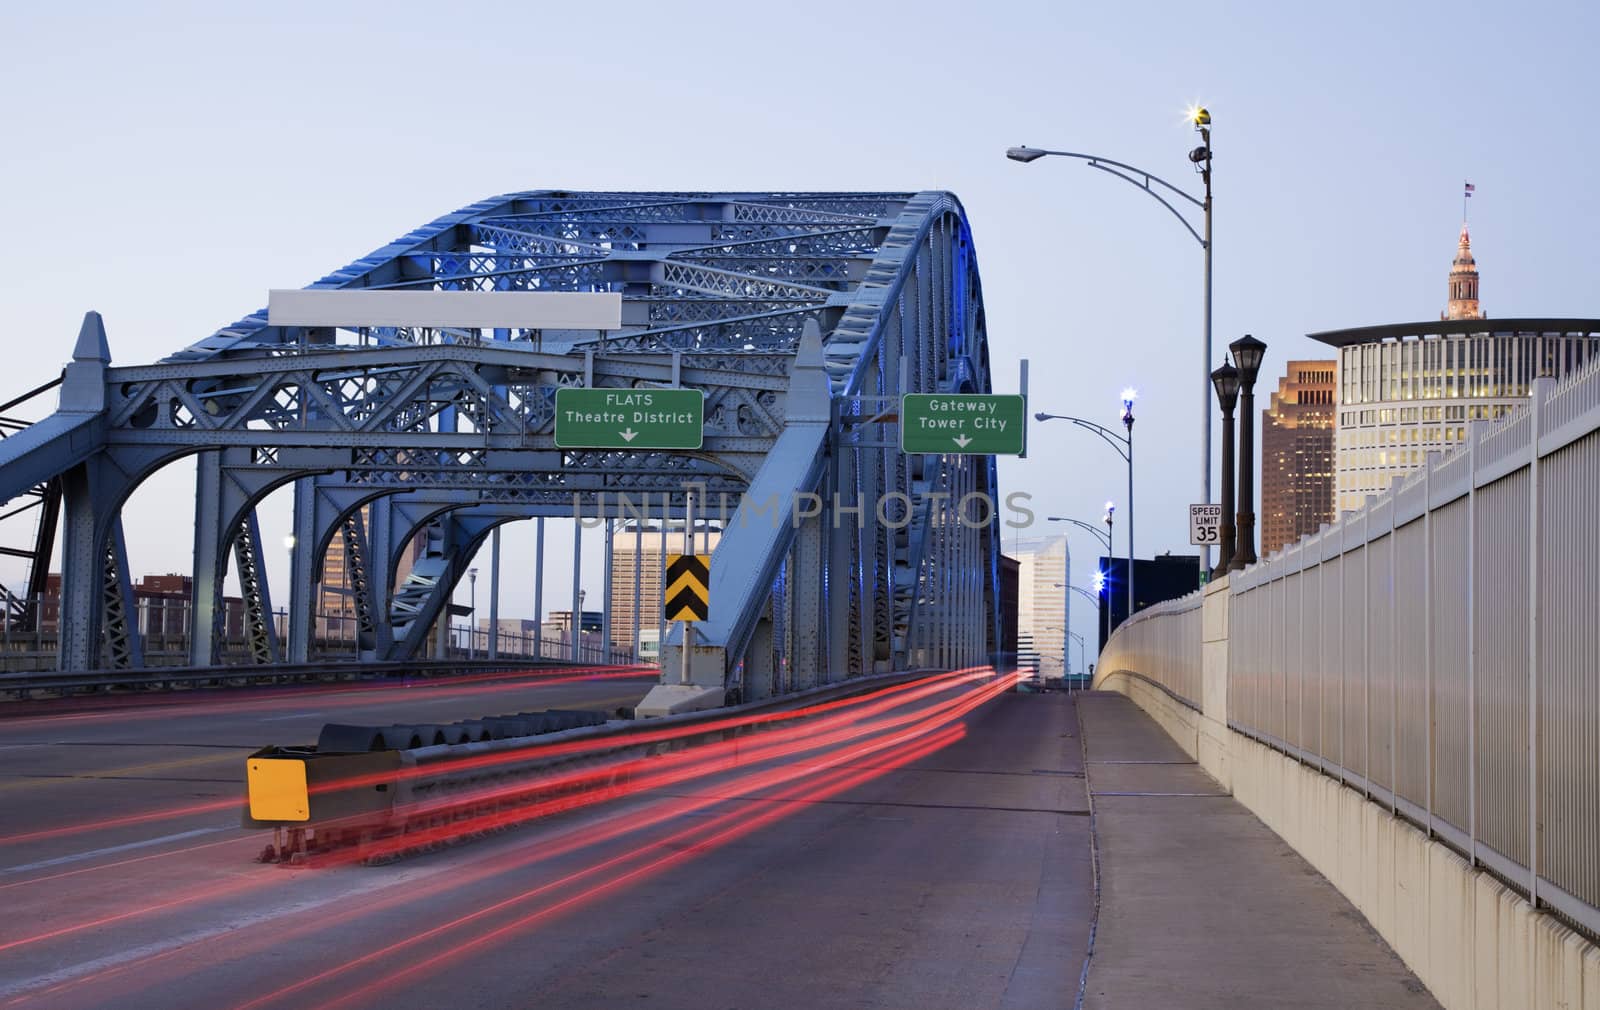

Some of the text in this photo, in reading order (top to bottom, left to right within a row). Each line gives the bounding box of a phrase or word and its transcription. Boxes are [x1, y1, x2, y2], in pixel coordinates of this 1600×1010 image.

[606, 394, 653, 406] FLATS
[929, 399, 997, 414] Gateway
[565, 411, 694, 424] Theatre District
[919, 417, 1007, 433] Tower City
[1192, 507, 1220, 515] SPEED
[1197, 526, 1217, 541] 35
